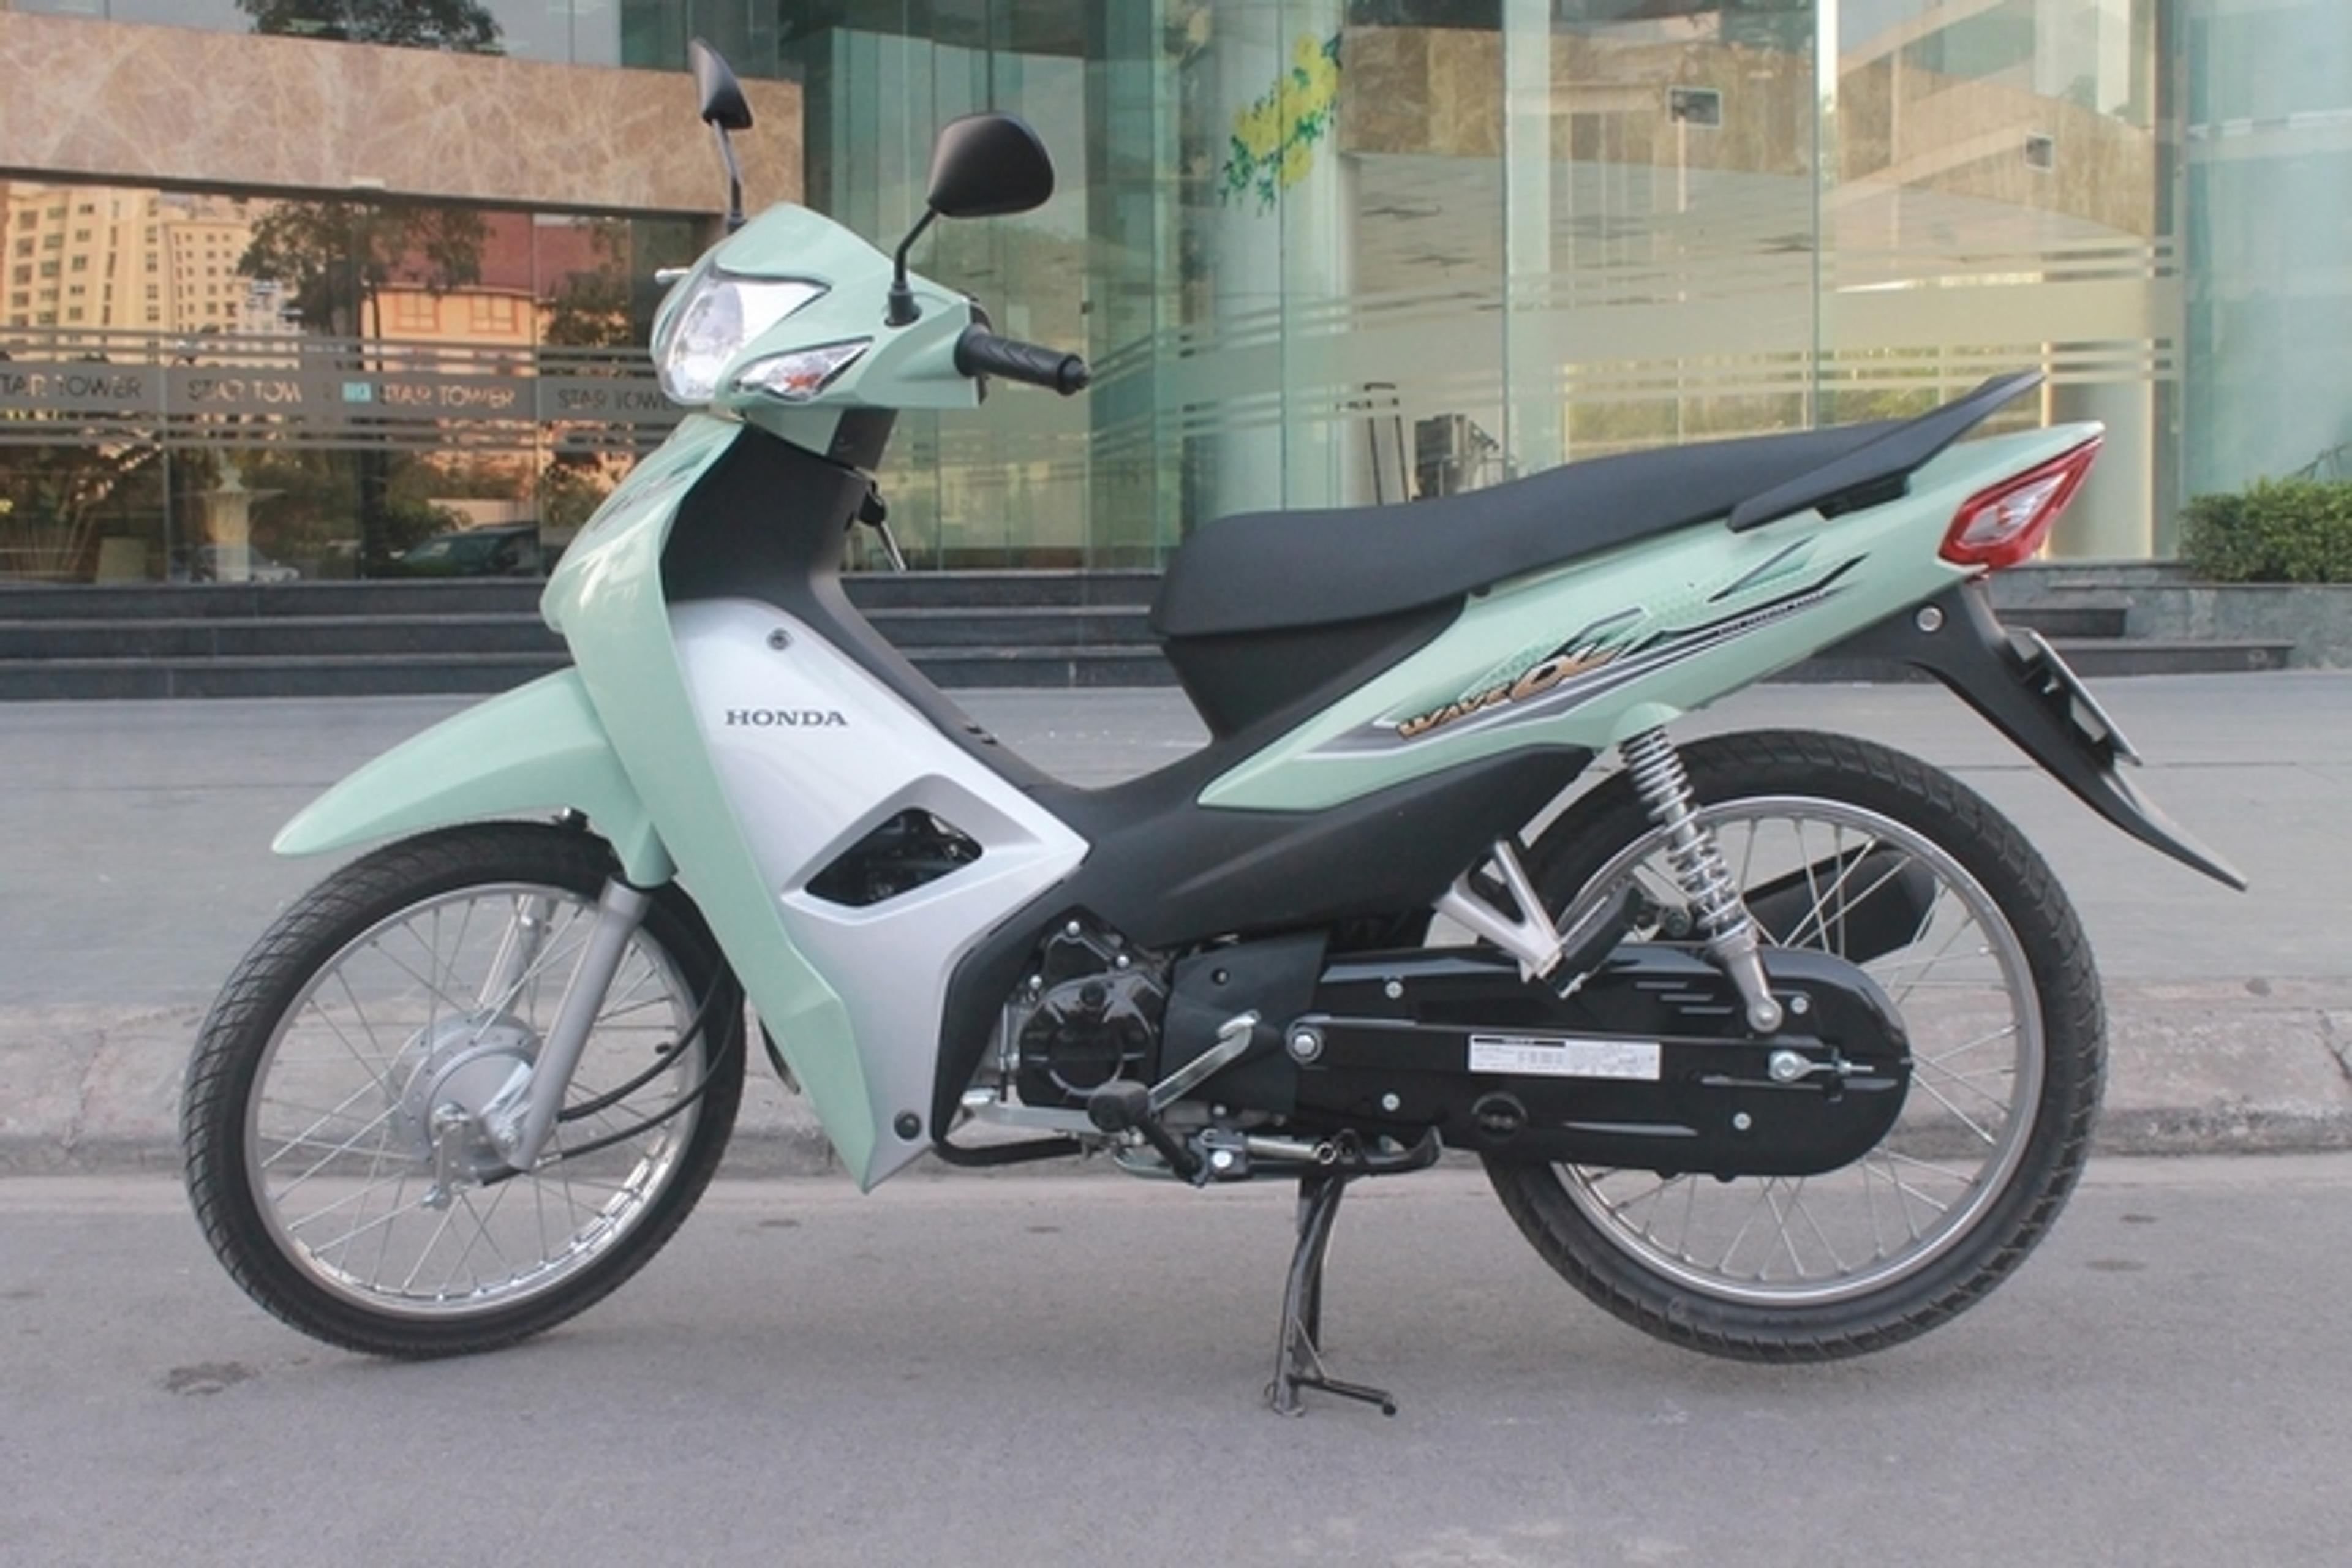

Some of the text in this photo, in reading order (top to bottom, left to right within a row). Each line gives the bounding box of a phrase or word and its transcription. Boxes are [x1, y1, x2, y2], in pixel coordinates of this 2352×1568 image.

[54, 374, 143, 399] TOWER
[437, 385, 515, 409] TOWER
[726, 710, 847, 726] HONDA
